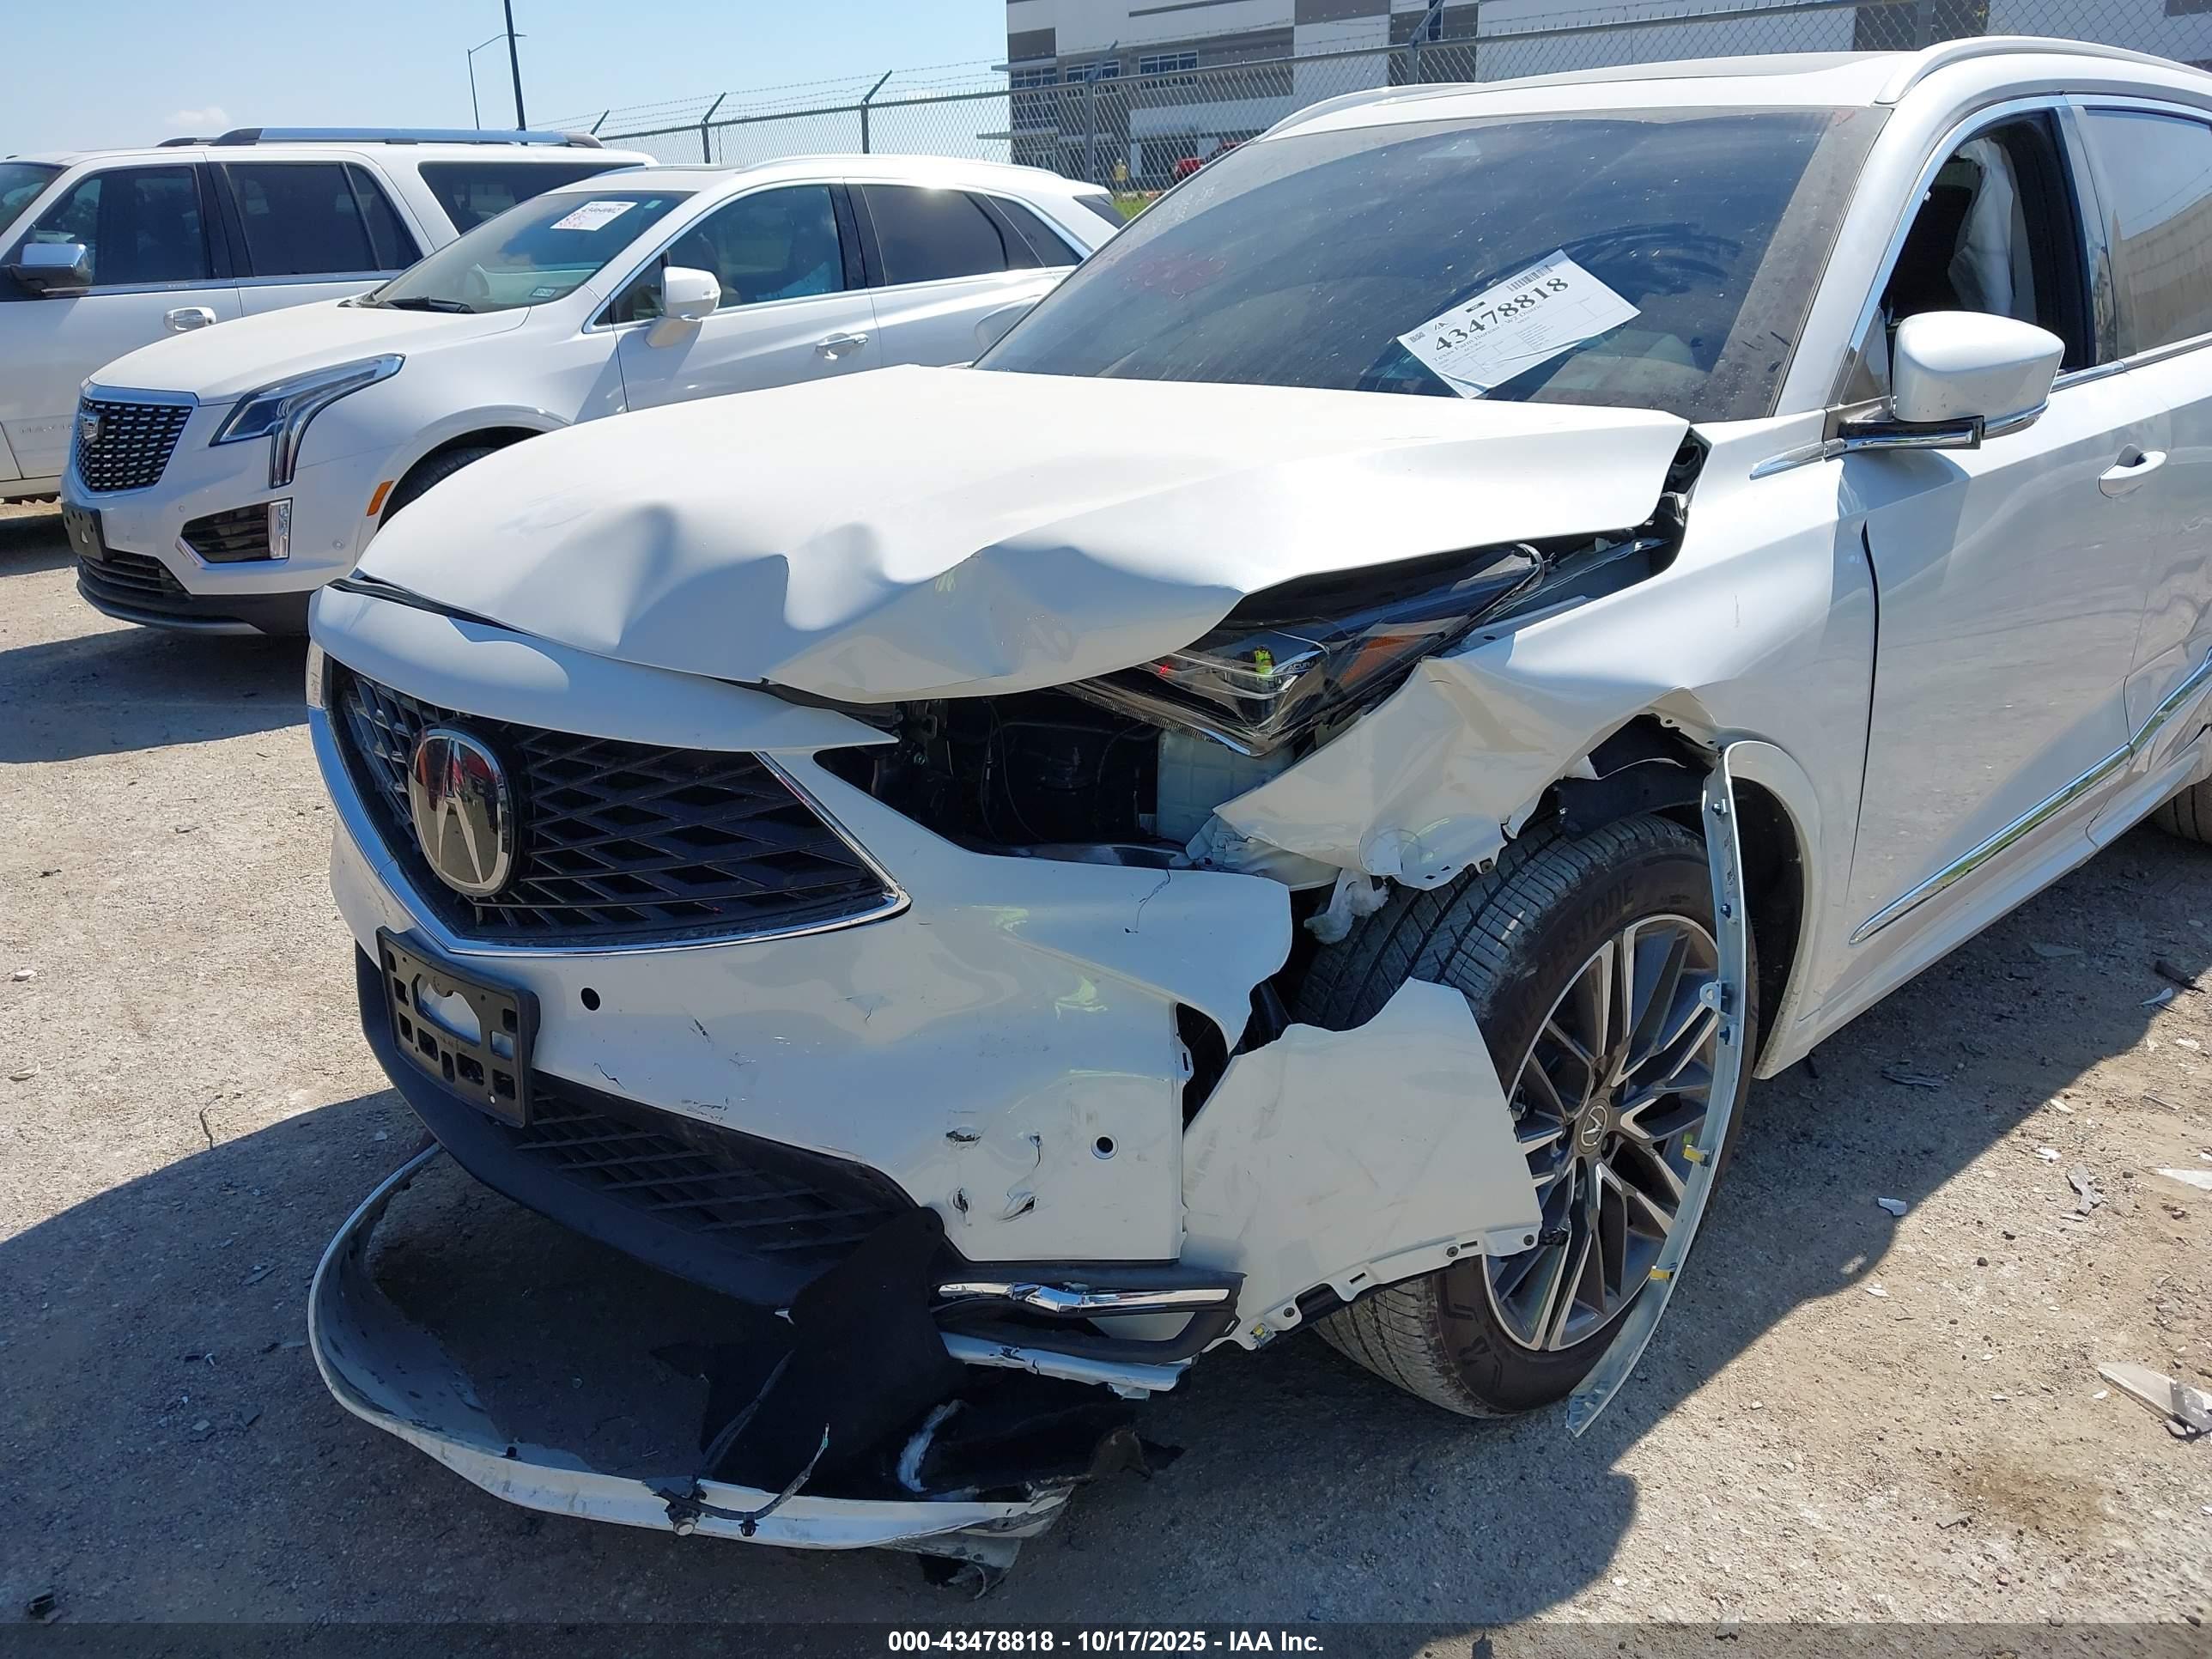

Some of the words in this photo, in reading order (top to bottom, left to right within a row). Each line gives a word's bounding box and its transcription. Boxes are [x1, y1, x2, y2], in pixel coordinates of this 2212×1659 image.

[1436, 277, 1569, 351] 43478818
[1432, 349, 1455, 362] Texas
[1455, 338, 1474, 350] Farm
